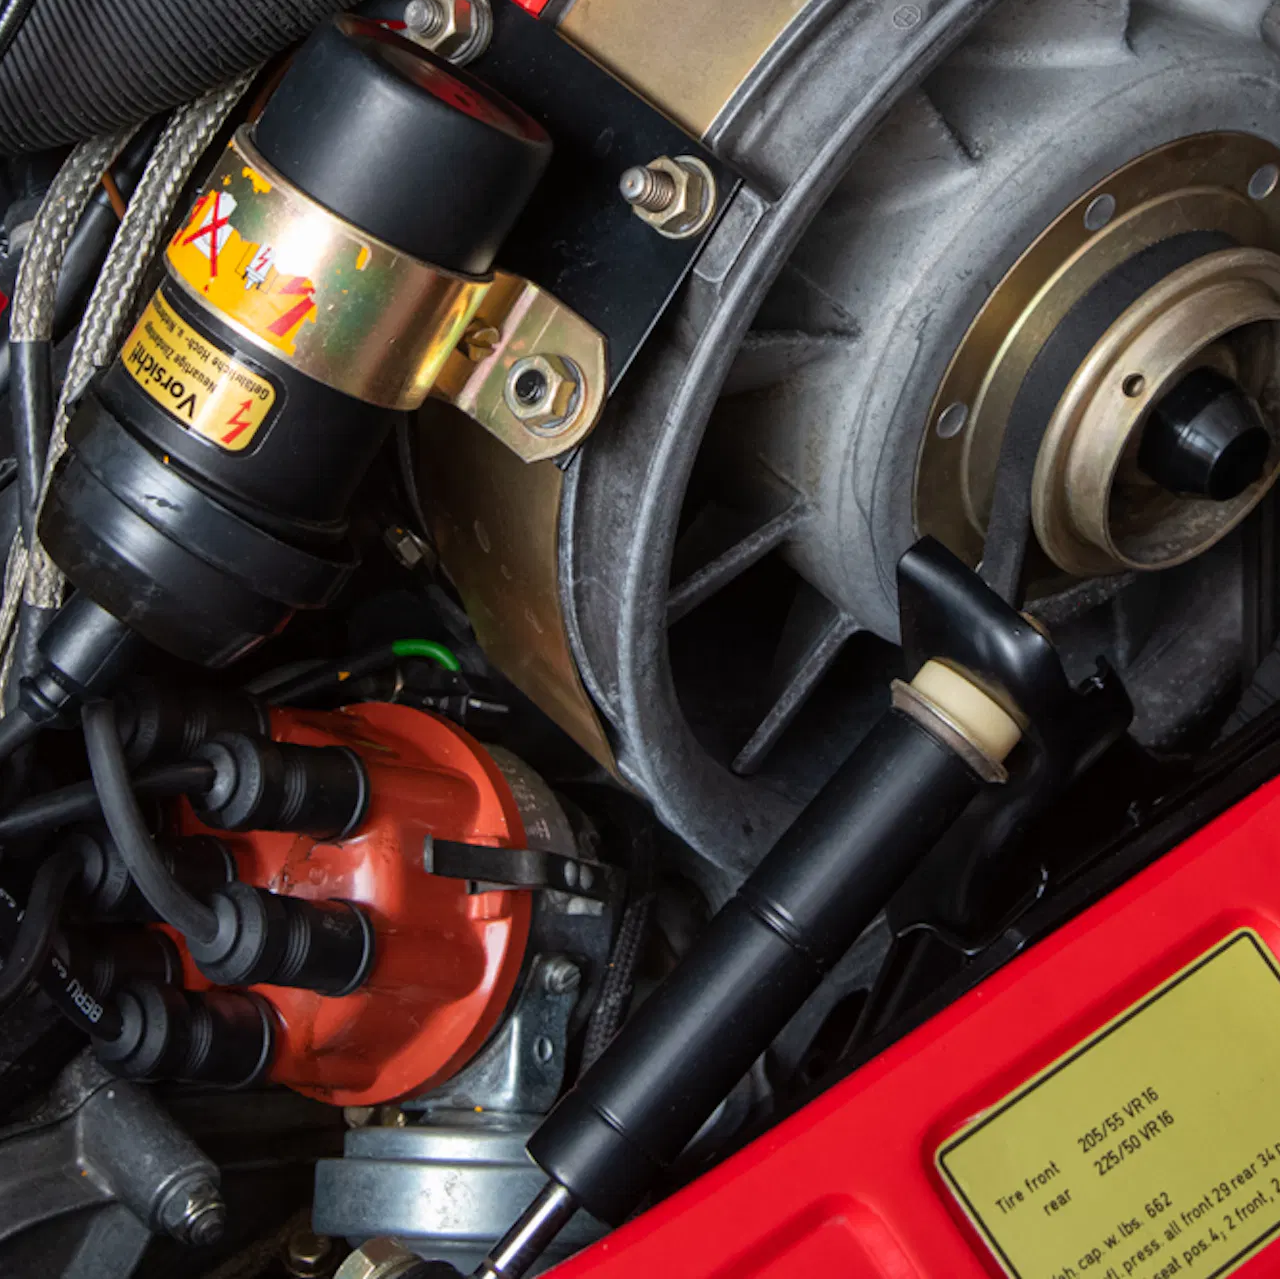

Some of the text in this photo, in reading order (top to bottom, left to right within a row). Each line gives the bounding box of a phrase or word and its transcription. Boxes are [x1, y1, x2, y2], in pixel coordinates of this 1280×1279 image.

[174, 353, 218, 393] Neuartige
[185, 336, 211, 362] Hoch-
[65, 978, 104, 1024] BERU
[995, 1190, 1025, 1214] Tire
[1024, 1160, 1061, 1194] front
[1043, 1189, 1071, 1216] rear
[1122, 1239, 1161, 1276] press.
[1163, 1220, 1182, 1242] all
[1180, 1195, 1215, 1227] front
[1211, 1182, 1232, 1204] 29
[1230, 1162, 1257, 1190] rear
[1256, 1148, 1276, 1168] 34
[1077, 1247, 1102, 1270] cap.
[1103, 1234, 1118, 1249] w.
[1117, 1218, 1142, 1238] lbs.
[1144, 1191, 1173, 1219] 662
[1182, 1239, 1209, 1267] pos.
[1223, 1214, 1237, 1231] 2
[1234, 1190, 1275, 1222] front,
